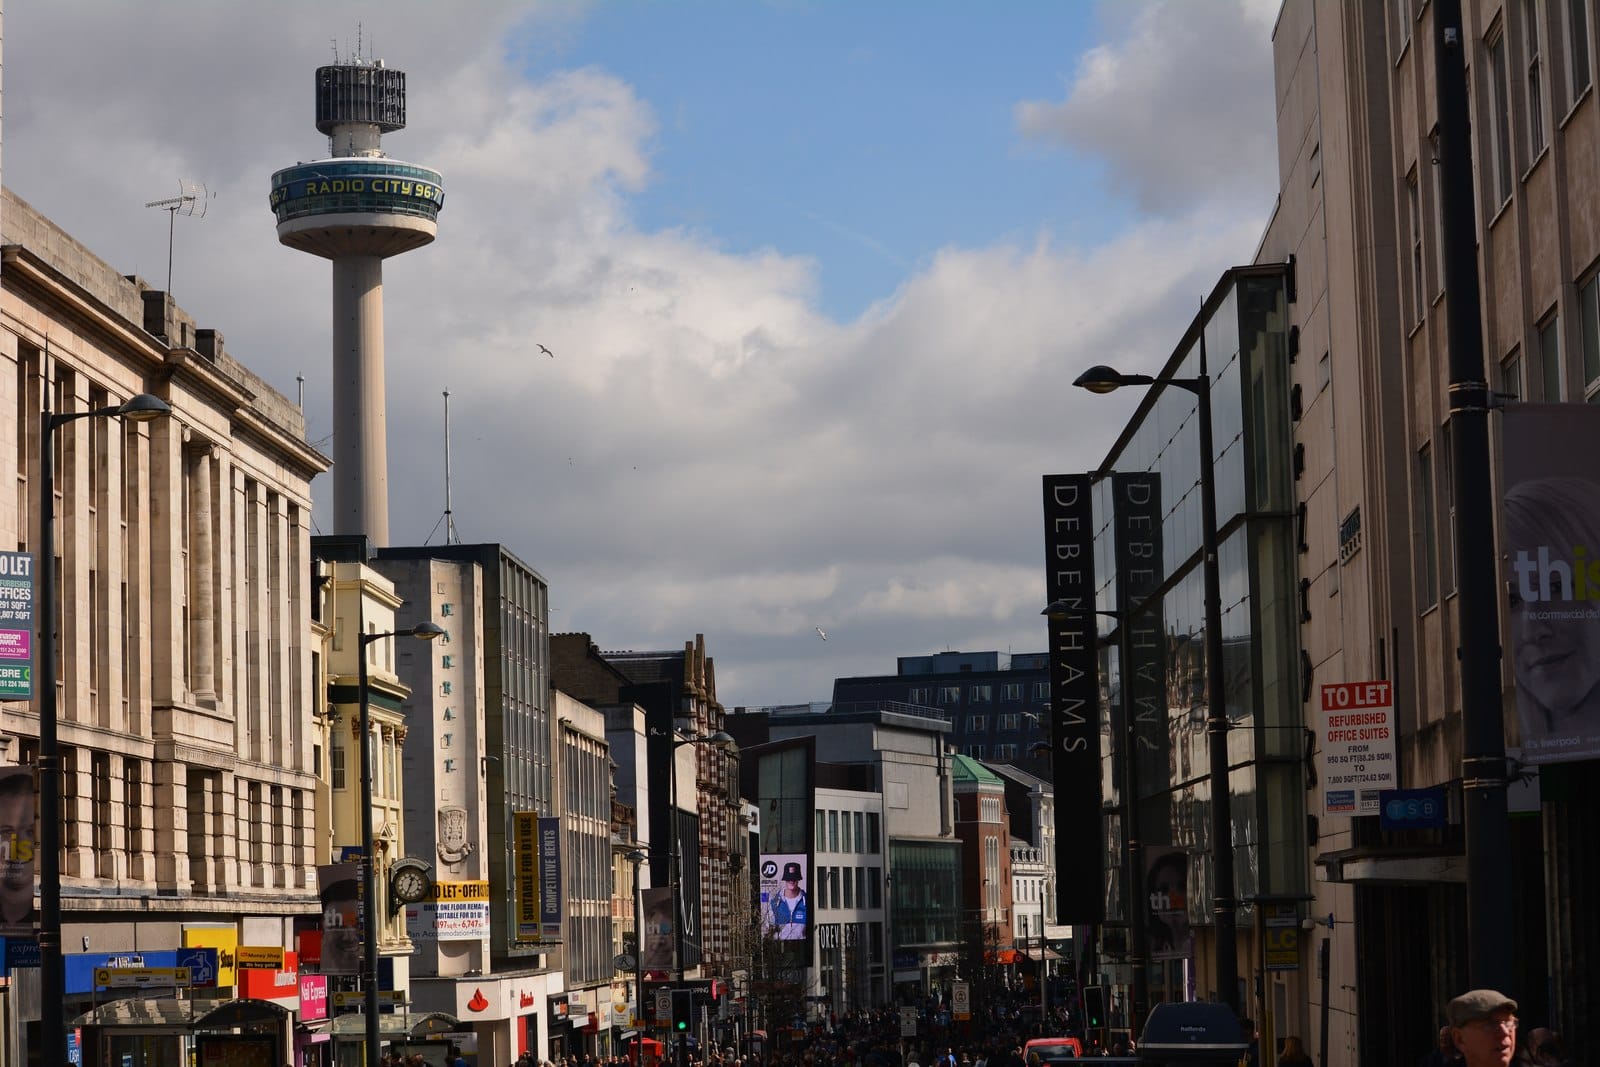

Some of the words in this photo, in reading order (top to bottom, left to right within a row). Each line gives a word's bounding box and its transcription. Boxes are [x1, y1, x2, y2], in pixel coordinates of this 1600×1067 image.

[306, 179, 364, 195] RADIO
[371, 179, 411, 196] CITY
[10, 555, 32, 577] LET
[1053, 483, 1088, 753] DEBENHAMS
[1323, 686, 1350, 708] TO
[1354, 683, 1389, 706] LET
[1328, 712, 1387, 728] REFURBISHED
[1327, 729, 1358, 743] OFFICE
[1359, 727, 1389, 741] SUITES
[1347, 745, 1370, 753] FROM
[1354, 764, 1366, 773] TO
[1390, 801, 1434, 816] TSB
[543, 829, 556, 857] RENTS
[521, 852, 533, 873] FOR
[763, 864, 776, 875] JD
[443, 884, 457, 898] LET
[544, 858, 558, 914] COMPETITIVE
